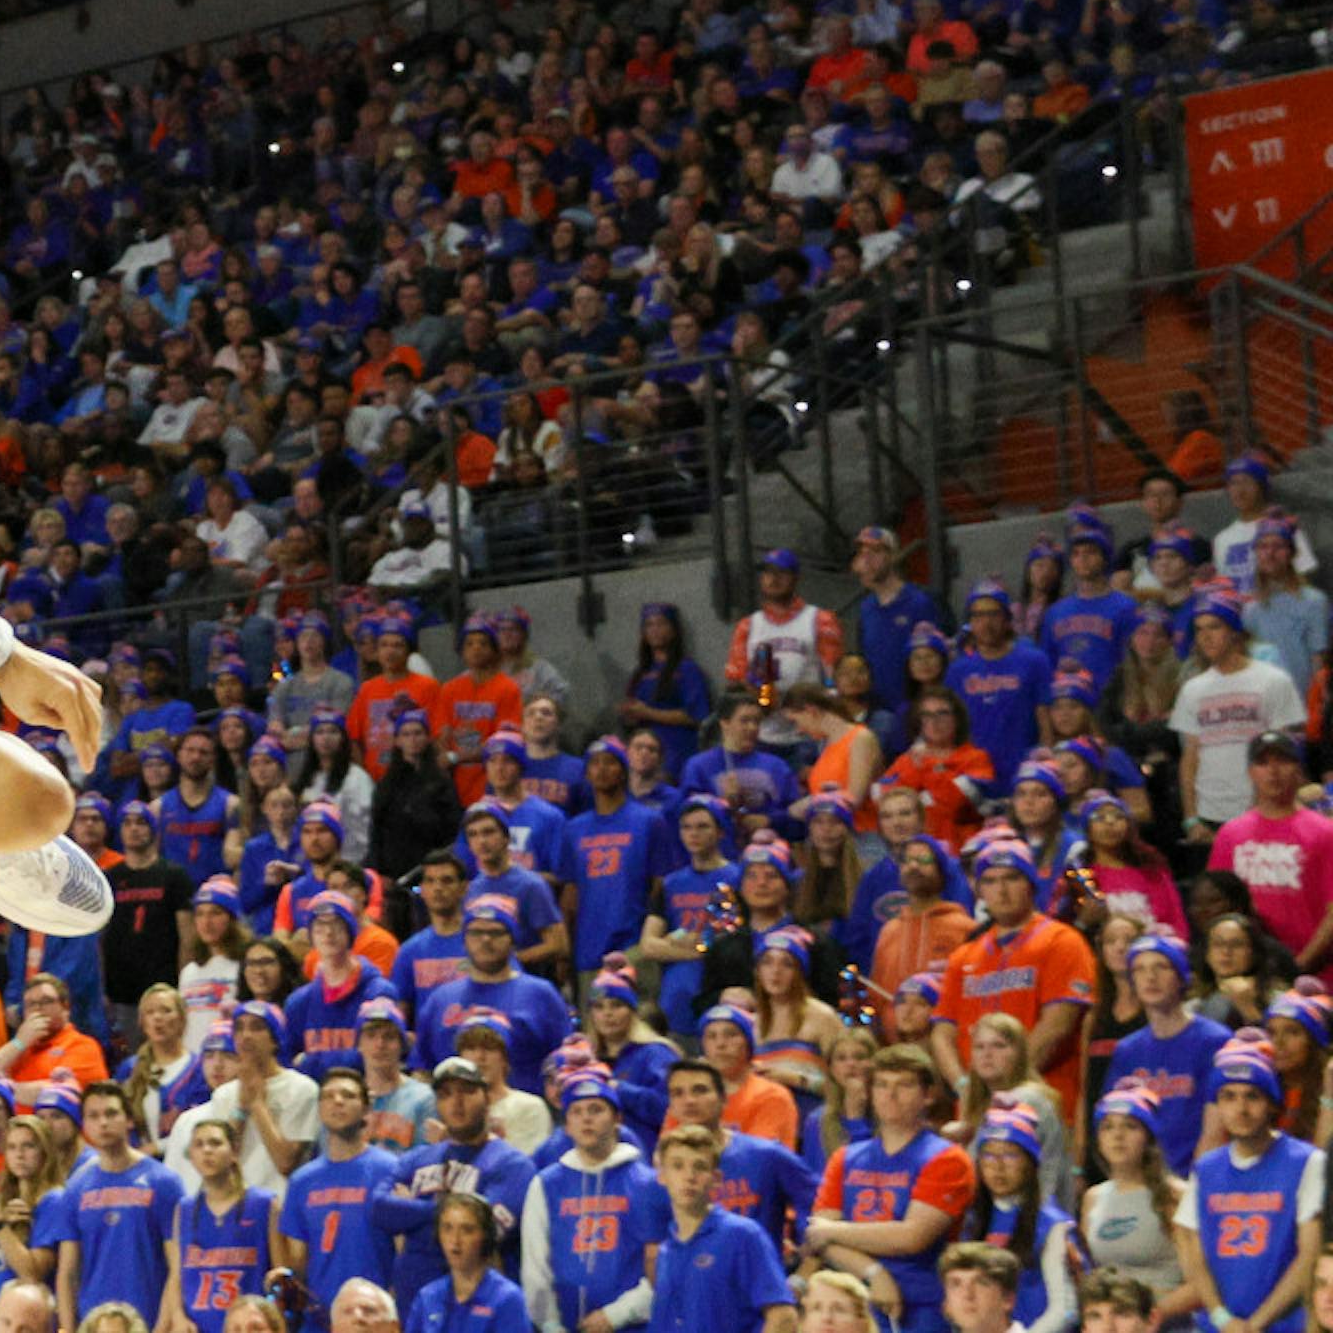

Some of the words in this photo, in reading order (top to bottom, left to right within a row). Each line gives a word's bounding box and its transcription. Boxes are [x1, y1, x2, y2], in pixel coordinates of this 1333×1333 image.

[1199, 105, 1287, 135] SECTION
[321, 1210, 341, 1253] 1
[572, 1215, 620, 1253] 23
[1216, 1214, 1270, 1258] 23
[192, 1269, 244, 1310] 13
